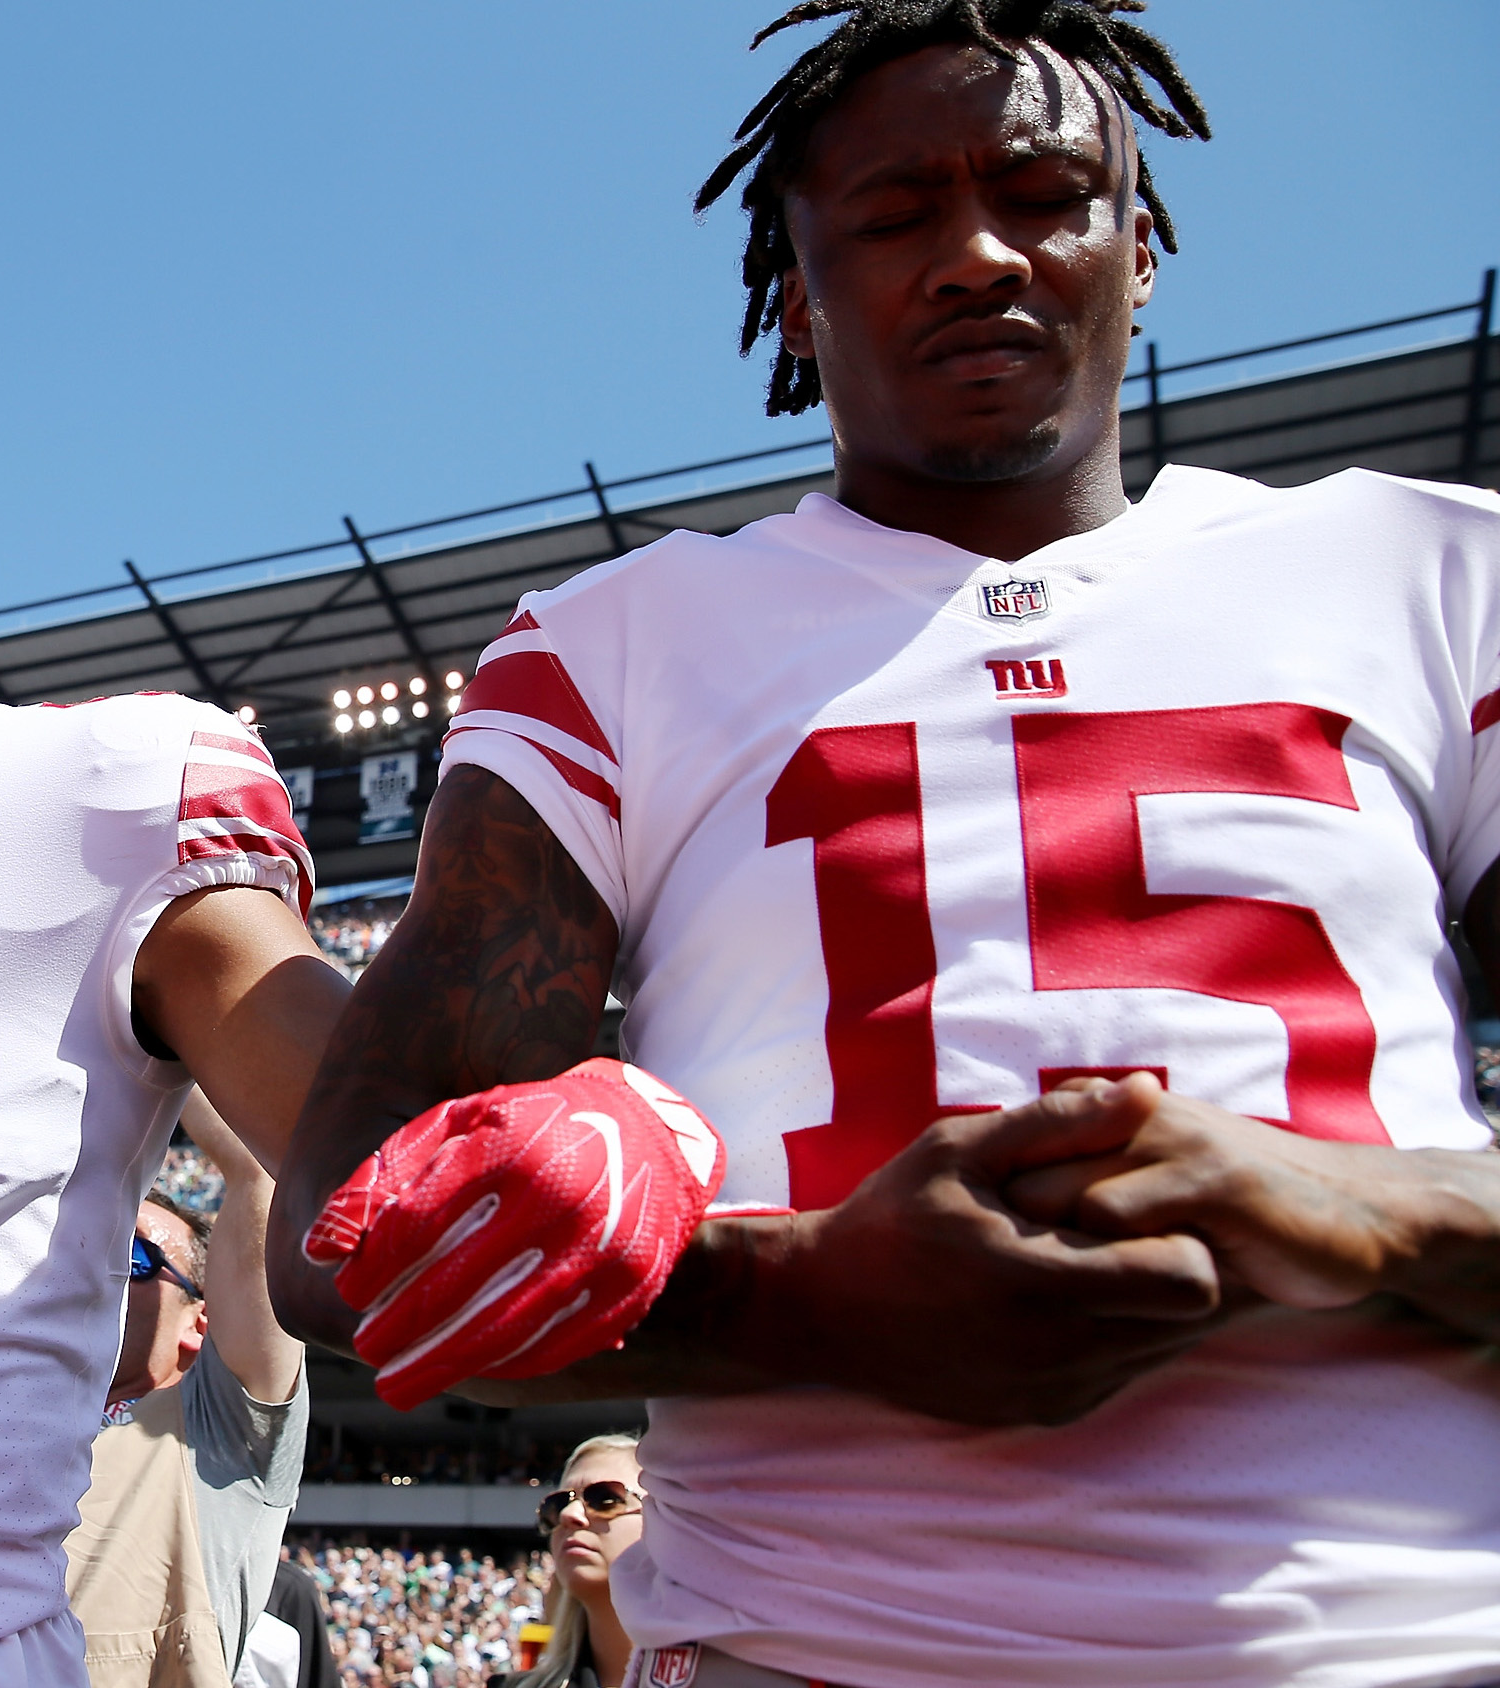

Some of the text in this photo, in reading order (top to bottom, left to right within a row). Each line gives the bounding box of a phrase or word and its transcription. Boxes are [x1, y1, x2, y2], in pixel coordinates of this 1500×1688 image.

[992, 594, 1042, 614] NFL
[765, 702, 1394, 1210] 15
[653, 1648, 688, 1685] NFL
